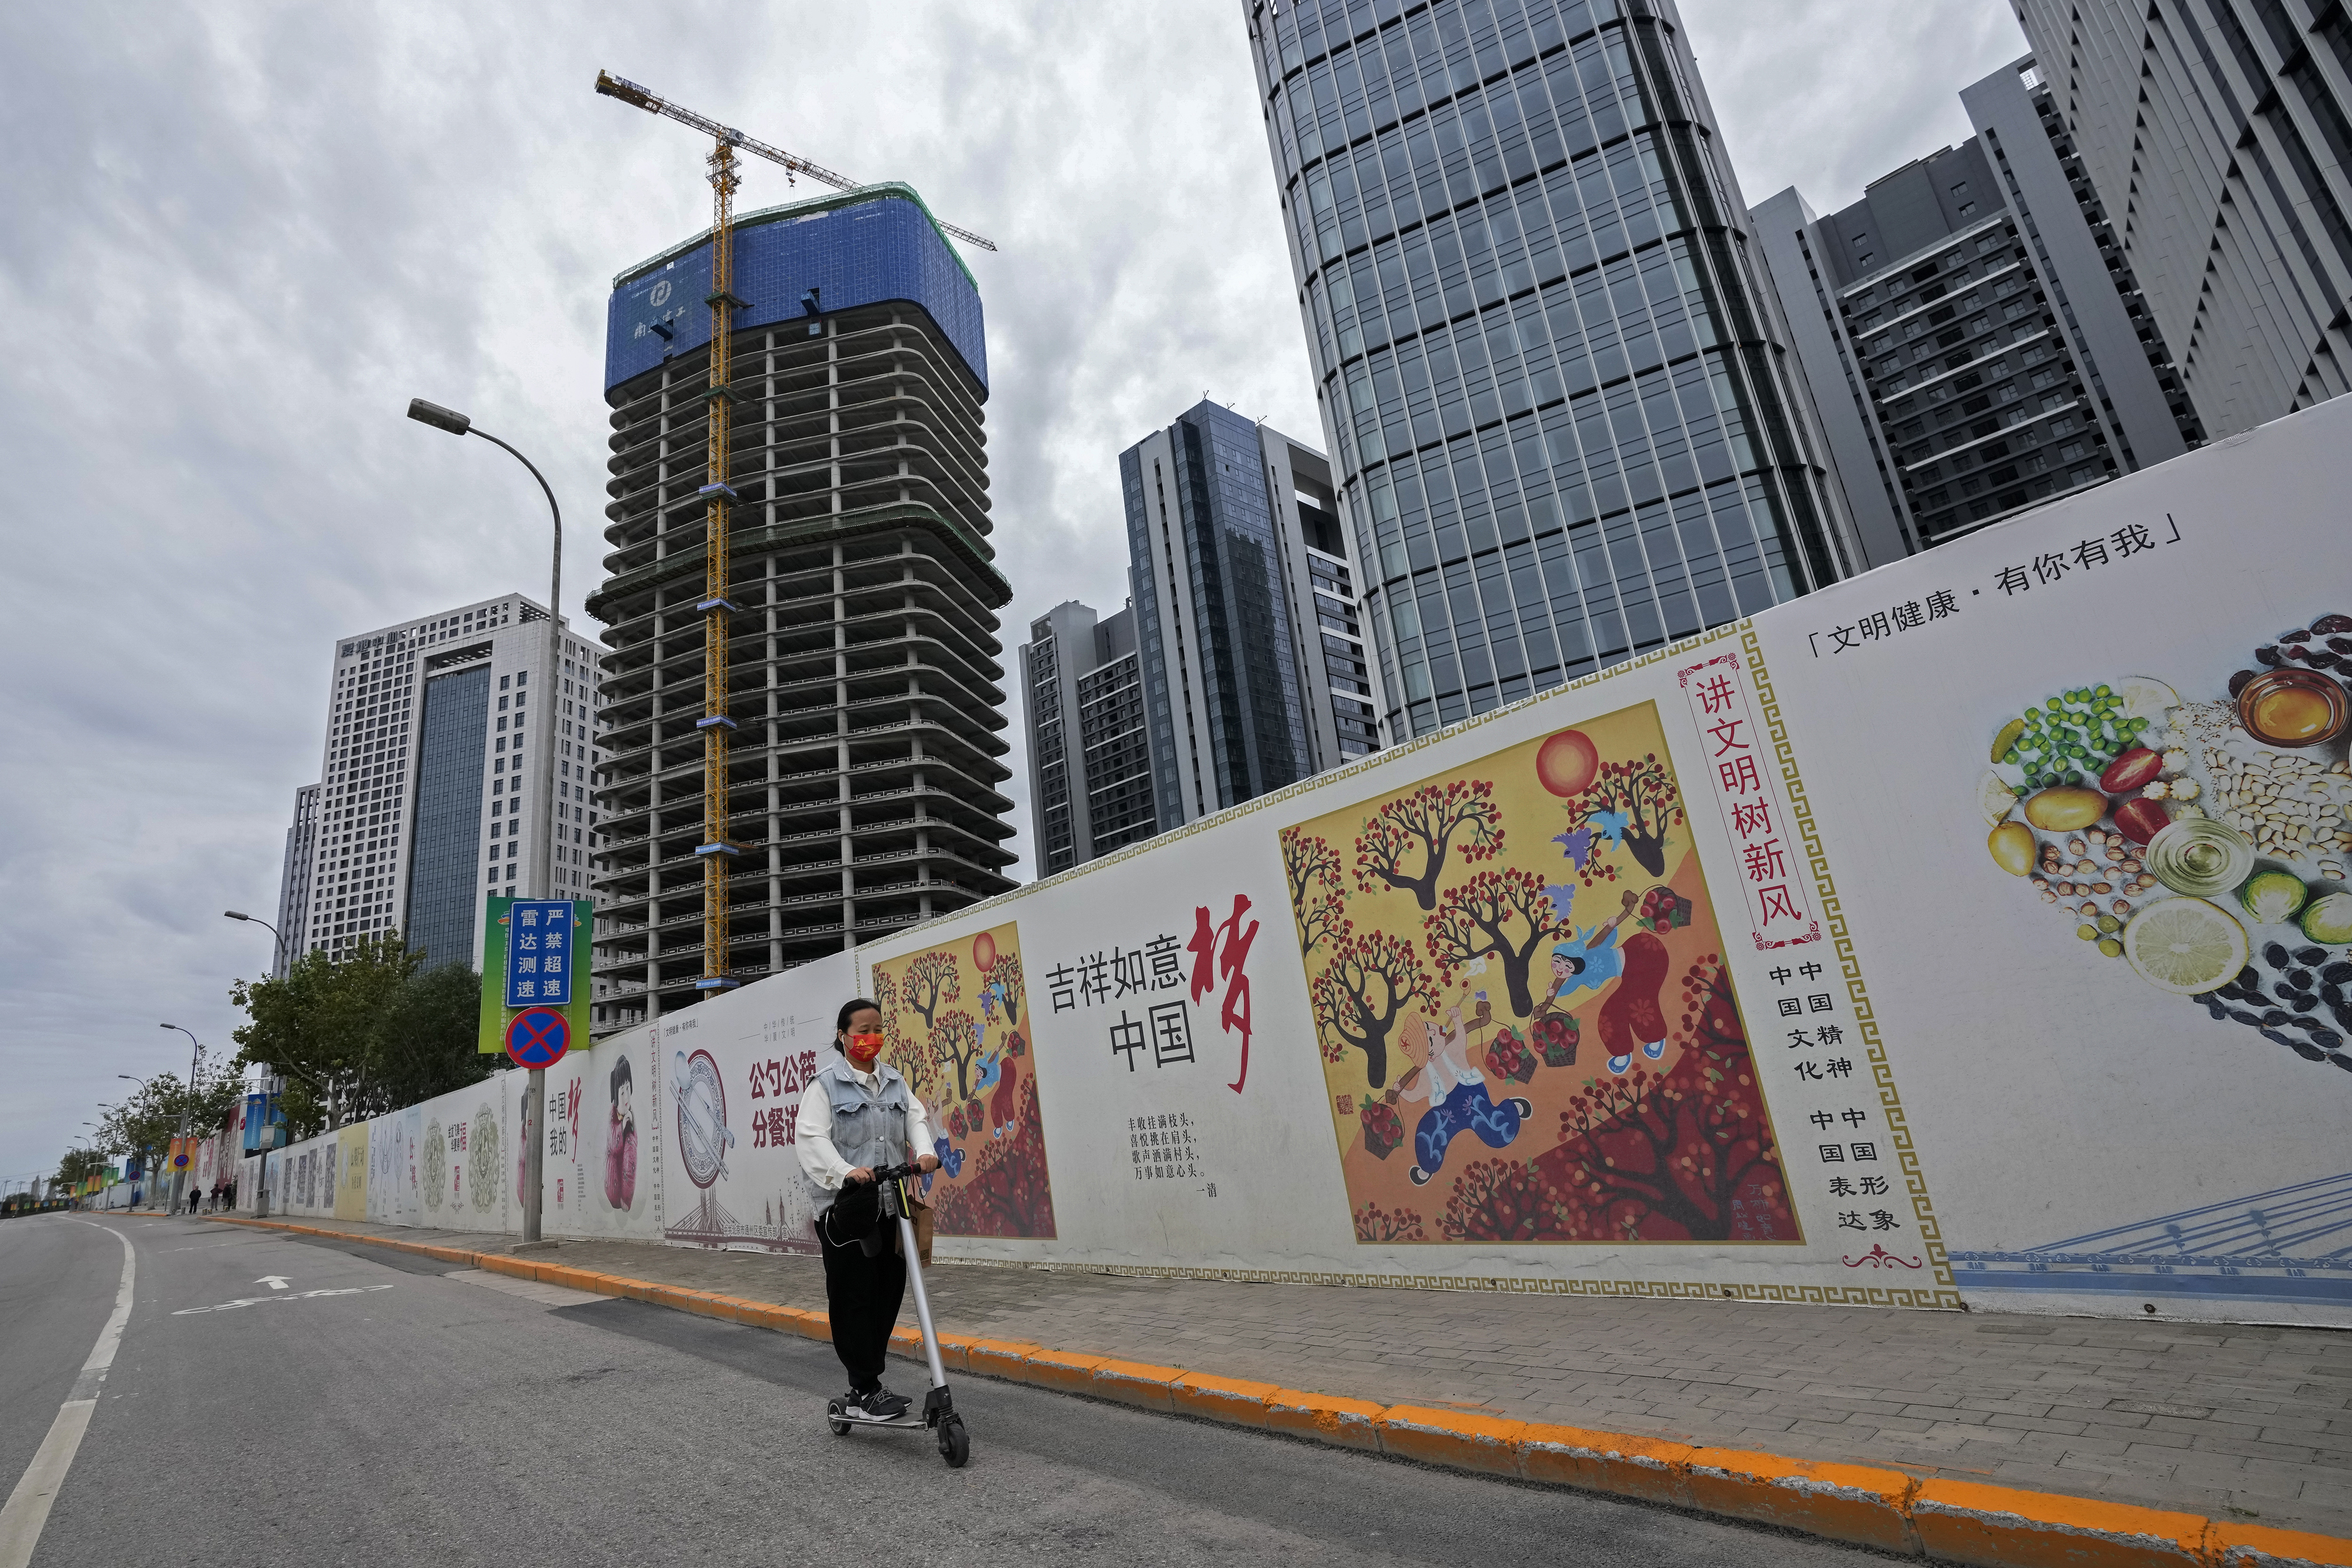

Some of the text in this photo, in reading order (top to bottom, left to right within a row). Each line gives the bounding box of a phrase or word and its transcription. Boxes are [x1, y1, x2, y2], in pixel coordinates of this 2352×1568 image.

[1696, 674, 1802, 927] 讲文明树新风
[516, 909, 539, 998] 雷达测速
[542, 909, 564, 997] 严禁超速
[1046, 933, 1187, 1014] 吉祥如意
[1186, 894, 1260, 1094] 梦
[1109, 1000, 1195, 1072] 中国
[549, 1091, 566, 1122] 中国
[1128, 1112, 1194, 1132] 丰收挂满枝头，
[550, 1126, 566, 1156] 我的
[1129, 1129, 1197, 1148] 喜悦挑在肩头，
[1131, 1146, 1200, 1164] 歌声洒满村头，
[1134, 1163, 1205, 1180] 万事如意心头。
[1196, 1182, 1217, 1198] 一清
